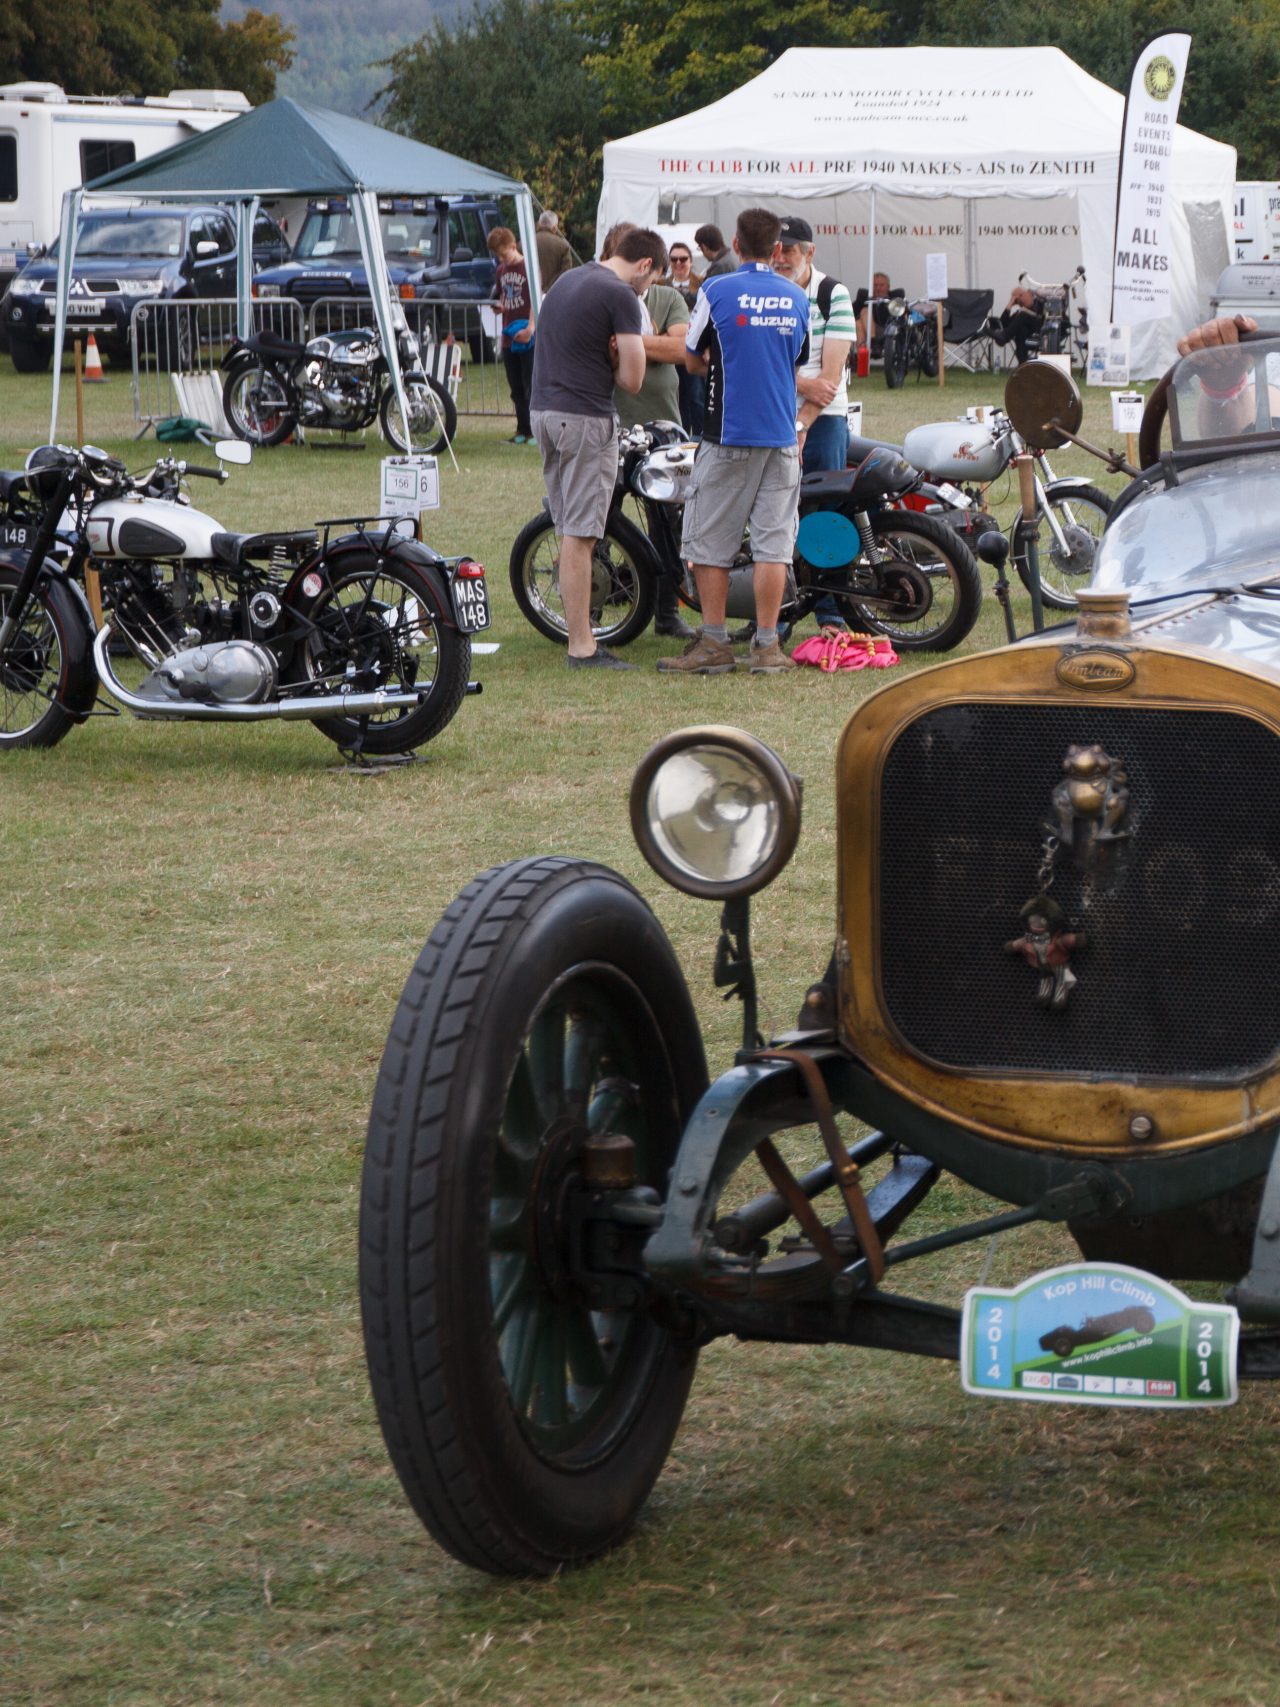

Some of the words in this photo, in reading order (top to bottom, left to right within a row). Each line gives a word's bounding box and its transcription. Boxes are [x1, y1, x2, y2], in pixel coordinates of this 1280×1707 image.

[1144, 112, 1168, 124] ROAD
[659, 158, 692, 173] THE
[697, 158, 743, 173] CLUB
[748, 159, 780, 174] FOR
[786, 159, 820, 174] ALL
[824, 160, 856, 174] PRE
[863, 160, 895, 174] 1940
[901, 160, 962, 175] MAKES
[976, 161, 1006, 175] AJS
[1010, 162, 1024, 174] to
[1029, 160, 1095, 175] ZENITH
[814, 224, 840, 236] THE
[882, 224, 908, 236] FOR
[911, 224, 936, 236] ALL
[938, 224, 963, 236] PRE
[978, 224, 1004, 236] 1940
[1007, 224, 1058, 236] MOTOR
[1132, 226, 1158, 246] ALL
[1117, 250, 1168, 272] MAKES
[738, 294, 793, 314] tyco
[750, 315, 797, 328] SUZUKI
[395, 478, 409, 489] 156
[4, 527, 27, 544] 148
[455, 579, 485, 603] MAS
[461, 603, 487, 627] 148
[1043, 1281, 1077, 1301] Kop
[1081, 1275, 1106, 1289] Hill
[1109, 1277, 1157, 1307] Climb
[986, 1306, 1003, 1380] 2014
[1197, 1321, 1214, 1393] 2014
